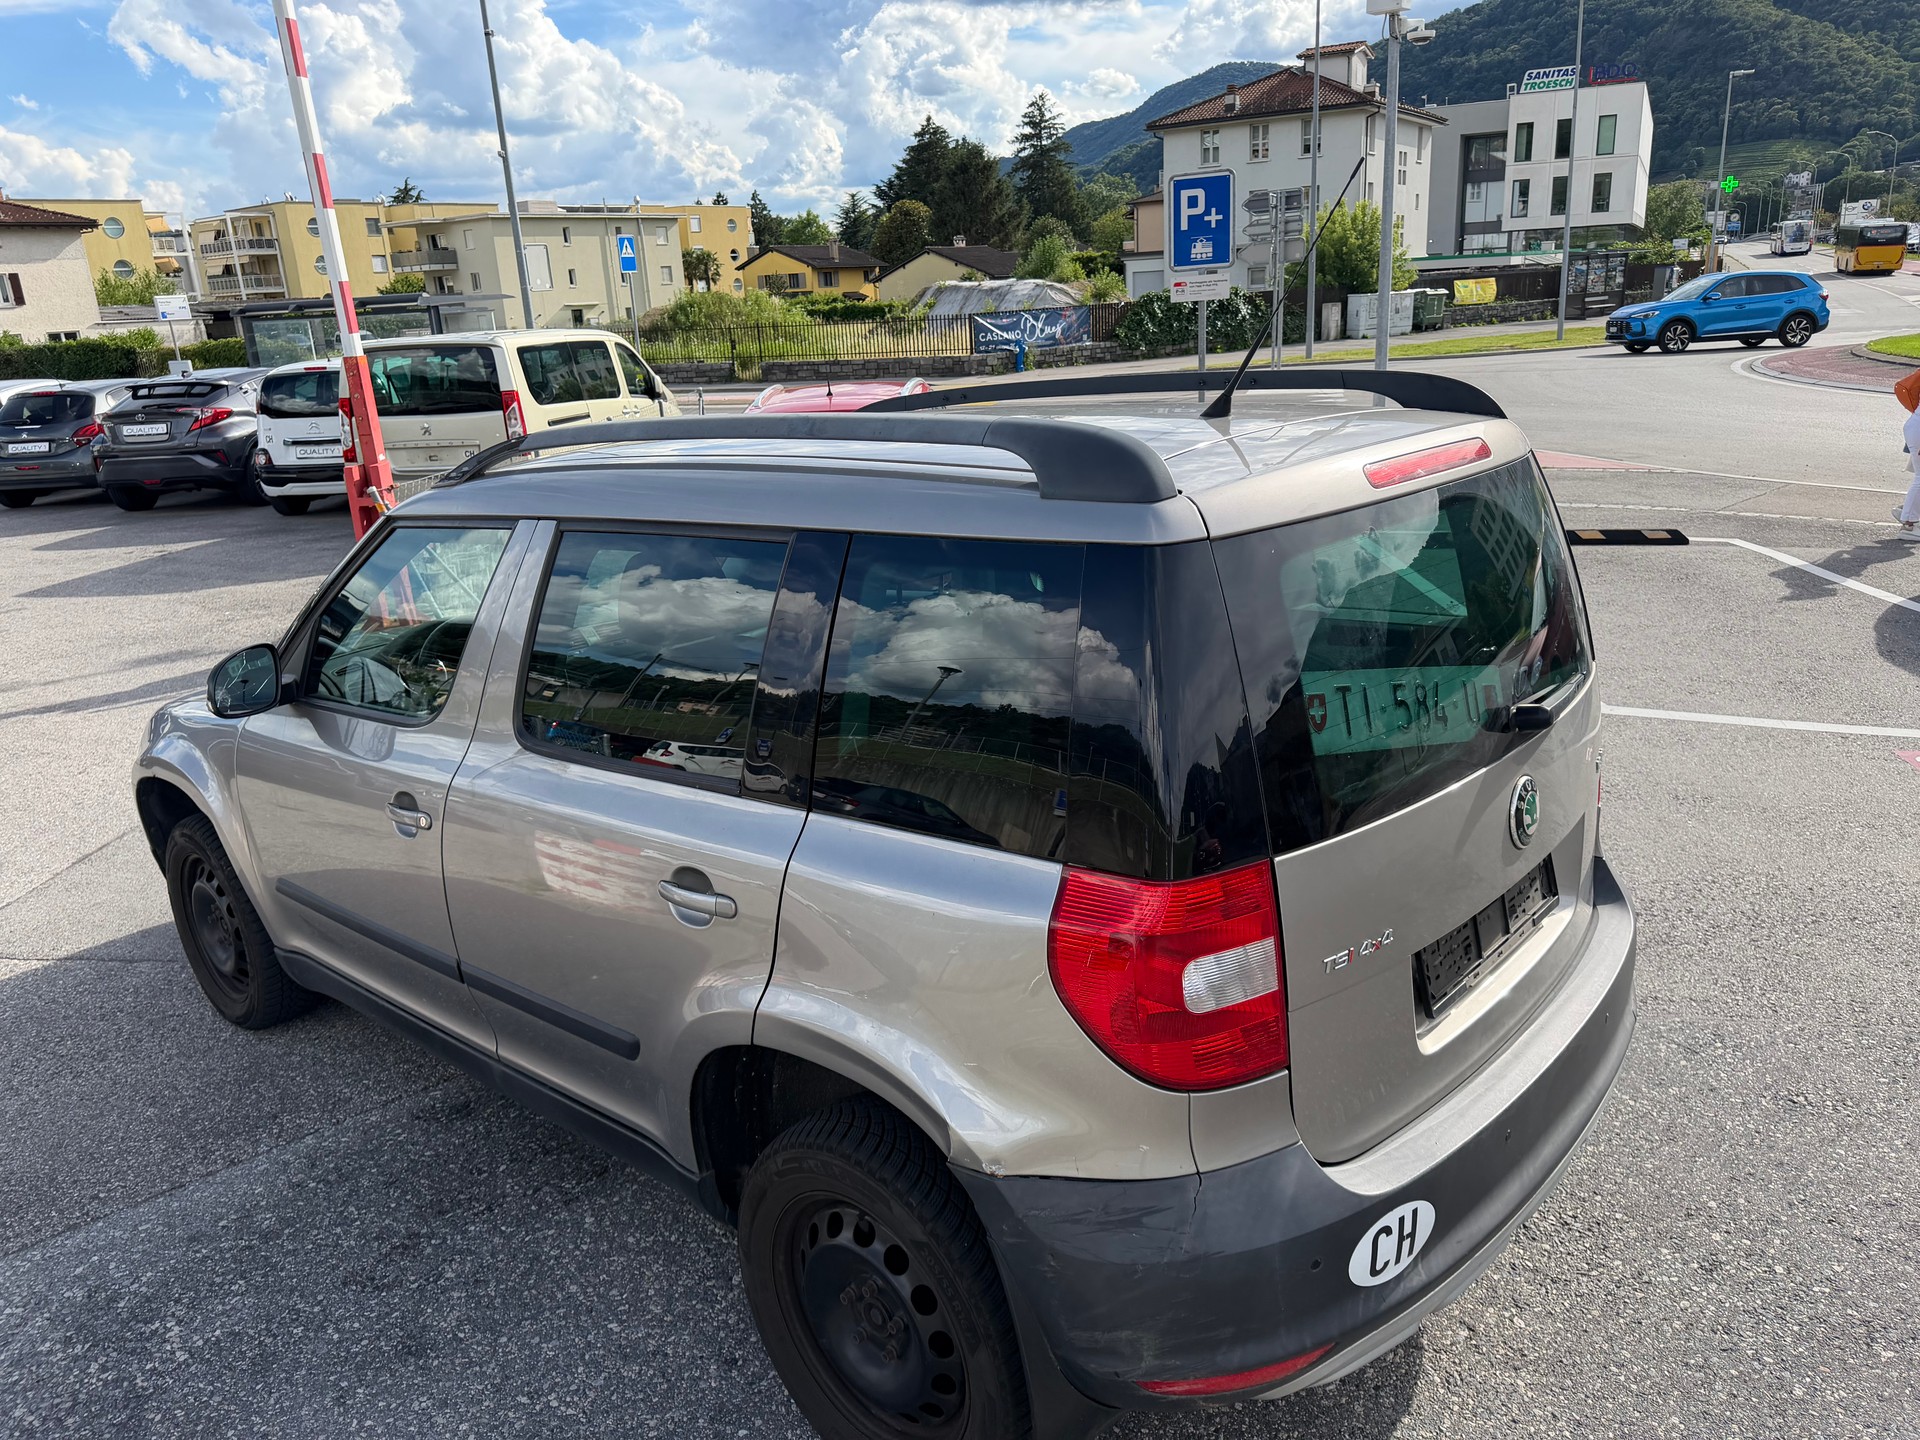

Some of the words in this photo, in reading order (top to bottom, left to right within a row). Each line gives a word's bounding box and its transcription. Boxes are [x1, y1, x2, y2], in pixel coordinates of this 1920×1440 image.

[1526, 67, 1576, 81] SANITAS
[1523, 78, 1574, 91] TROESCH
[979, 330, 1021, 342] CASLANO
[1020, 312, 1067, 342] Blues
[298, 447, 335, 456] QUALITY
[464, 450, 475, 458] CH
[1322, 946, 1354, 974] TSI
[1359, 928, 1394, 957] 4x4
[1369, 1206, 1418, 1278] CH
